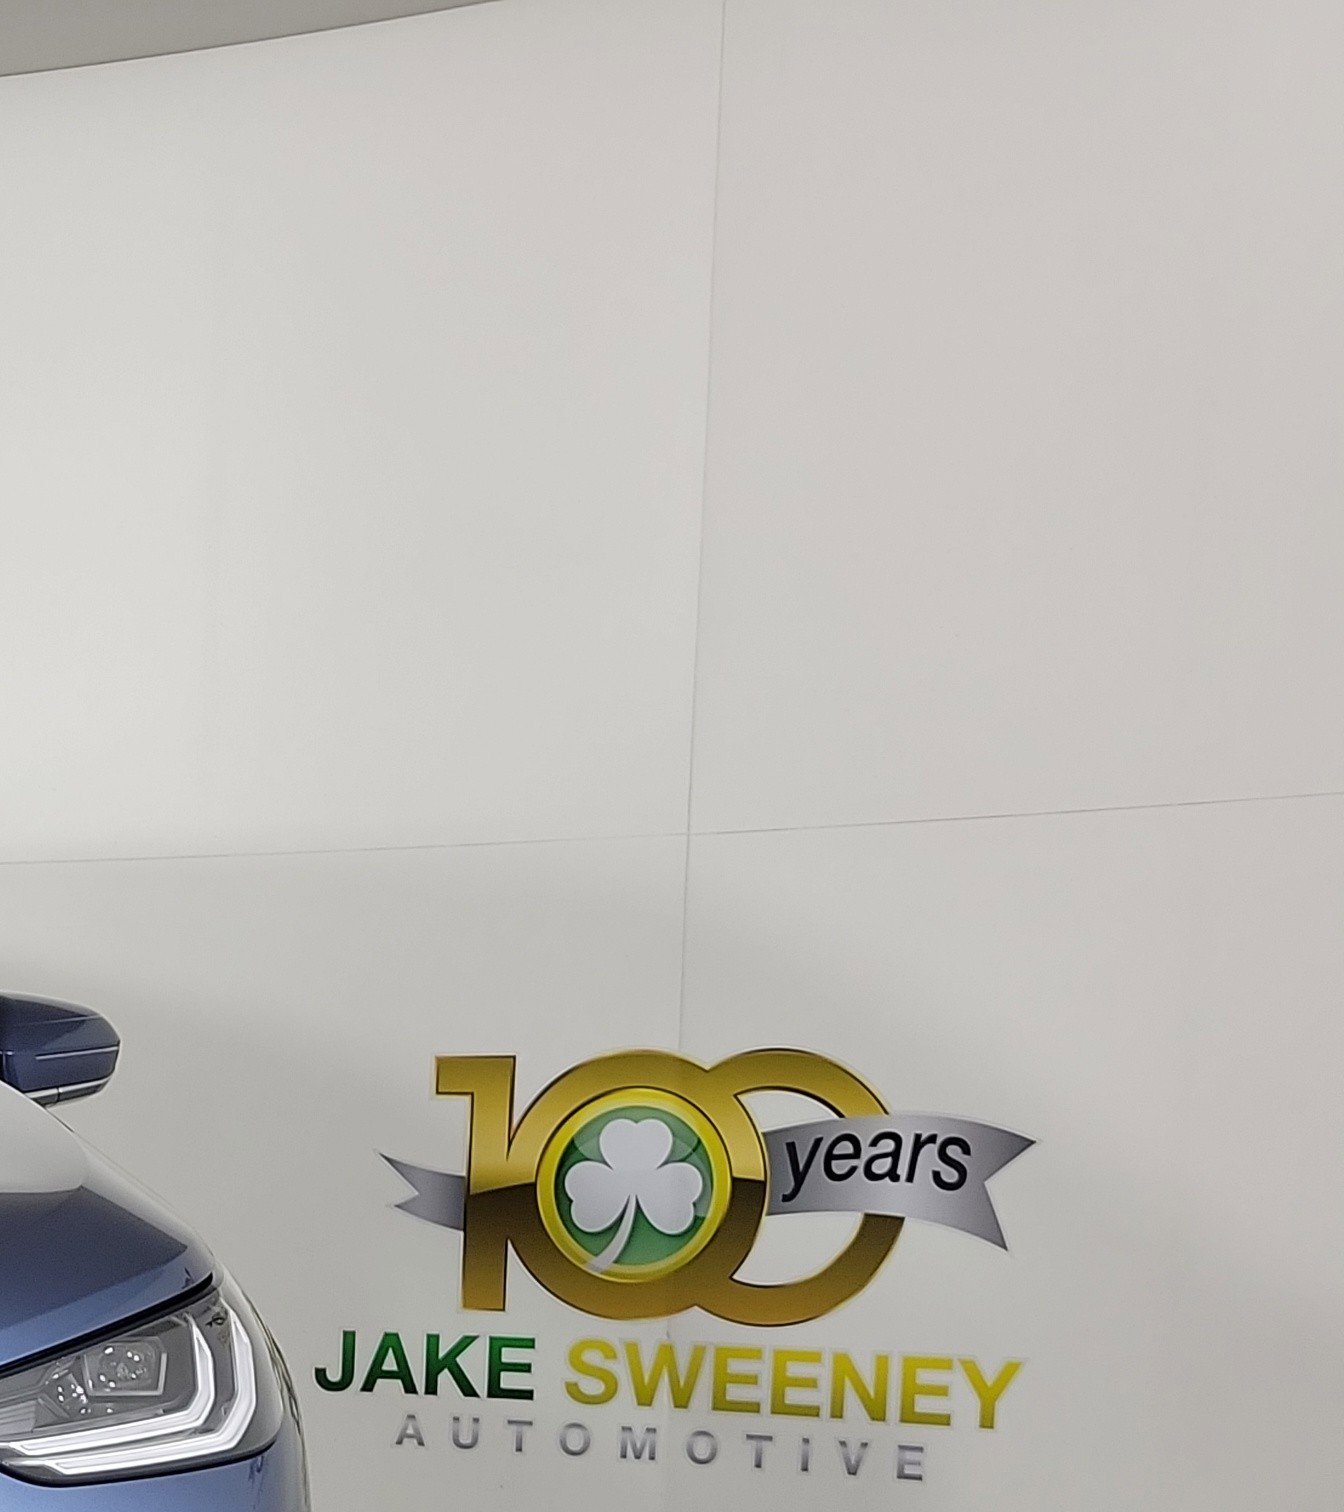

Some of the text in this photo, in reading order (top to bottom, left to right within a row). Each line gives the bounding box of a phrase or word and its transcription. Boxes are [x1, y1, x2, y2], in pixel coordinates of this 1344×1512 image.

[434, 1047, 972, 1327] 100 years
[314, 1330, 1022, 1430] JAKE SWEENEY
[394, 1414, 925, 1482] AUTOMOTIVE
